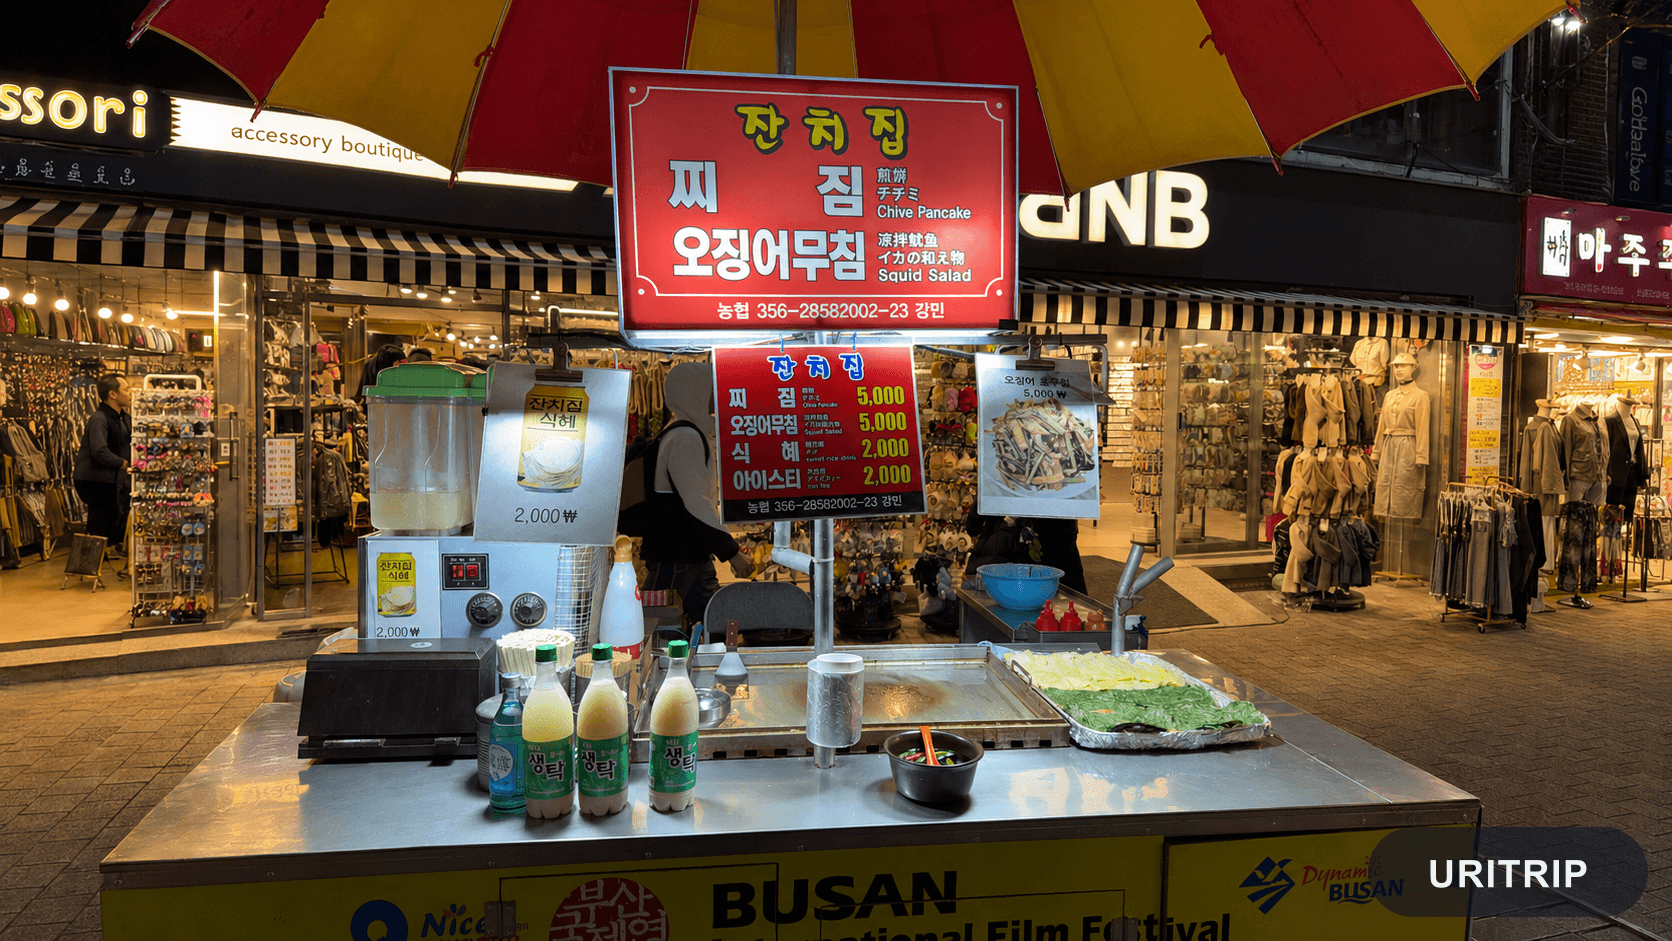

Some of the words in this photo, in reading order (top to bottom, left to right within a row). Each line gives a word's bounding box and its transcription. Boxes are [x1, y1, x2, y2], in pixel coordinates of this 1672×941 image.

[0, 83, 148, 138] ssori
[231, 126, 333, 154] accessory
[341, 135, 424, 163] boutique
[877, 204, 913, 219] Chive
[917, 205, 971, 219] Pancake
[672, 226, 866, 281] 오징어무침
[877, 249, 965, 266] イカの和え物
[878, 268, 922, 284] Squid
[928, 268, 972, 282] Salad
[717, 302, 749, 319] 농협
[757, 303, 909, 319] 356-28582002-23
[915, 302, 945, 318] 강민
[857, 386, 905, 407] 5,000
[730, 414, 799, 436] 오징어무침
[859, 412, 907, 432] 5,000
[861, 437, 909, 459] 2,000
[733, 468, 801, 492] 아이스티
[863, 464, 911, 486] 2,000
[774, 497, 878, 512] 356-28582002-23
[527, 752, 566, 782] 생탁
[580, 750, 617, 780] 생탁
[1302, 857, 1384, 891] Dynamic
[712, 870, 958, 929] BUSAN
[1329, 879, 1405, 903] BUSAN
[988, 919, 1069, 941] Film
